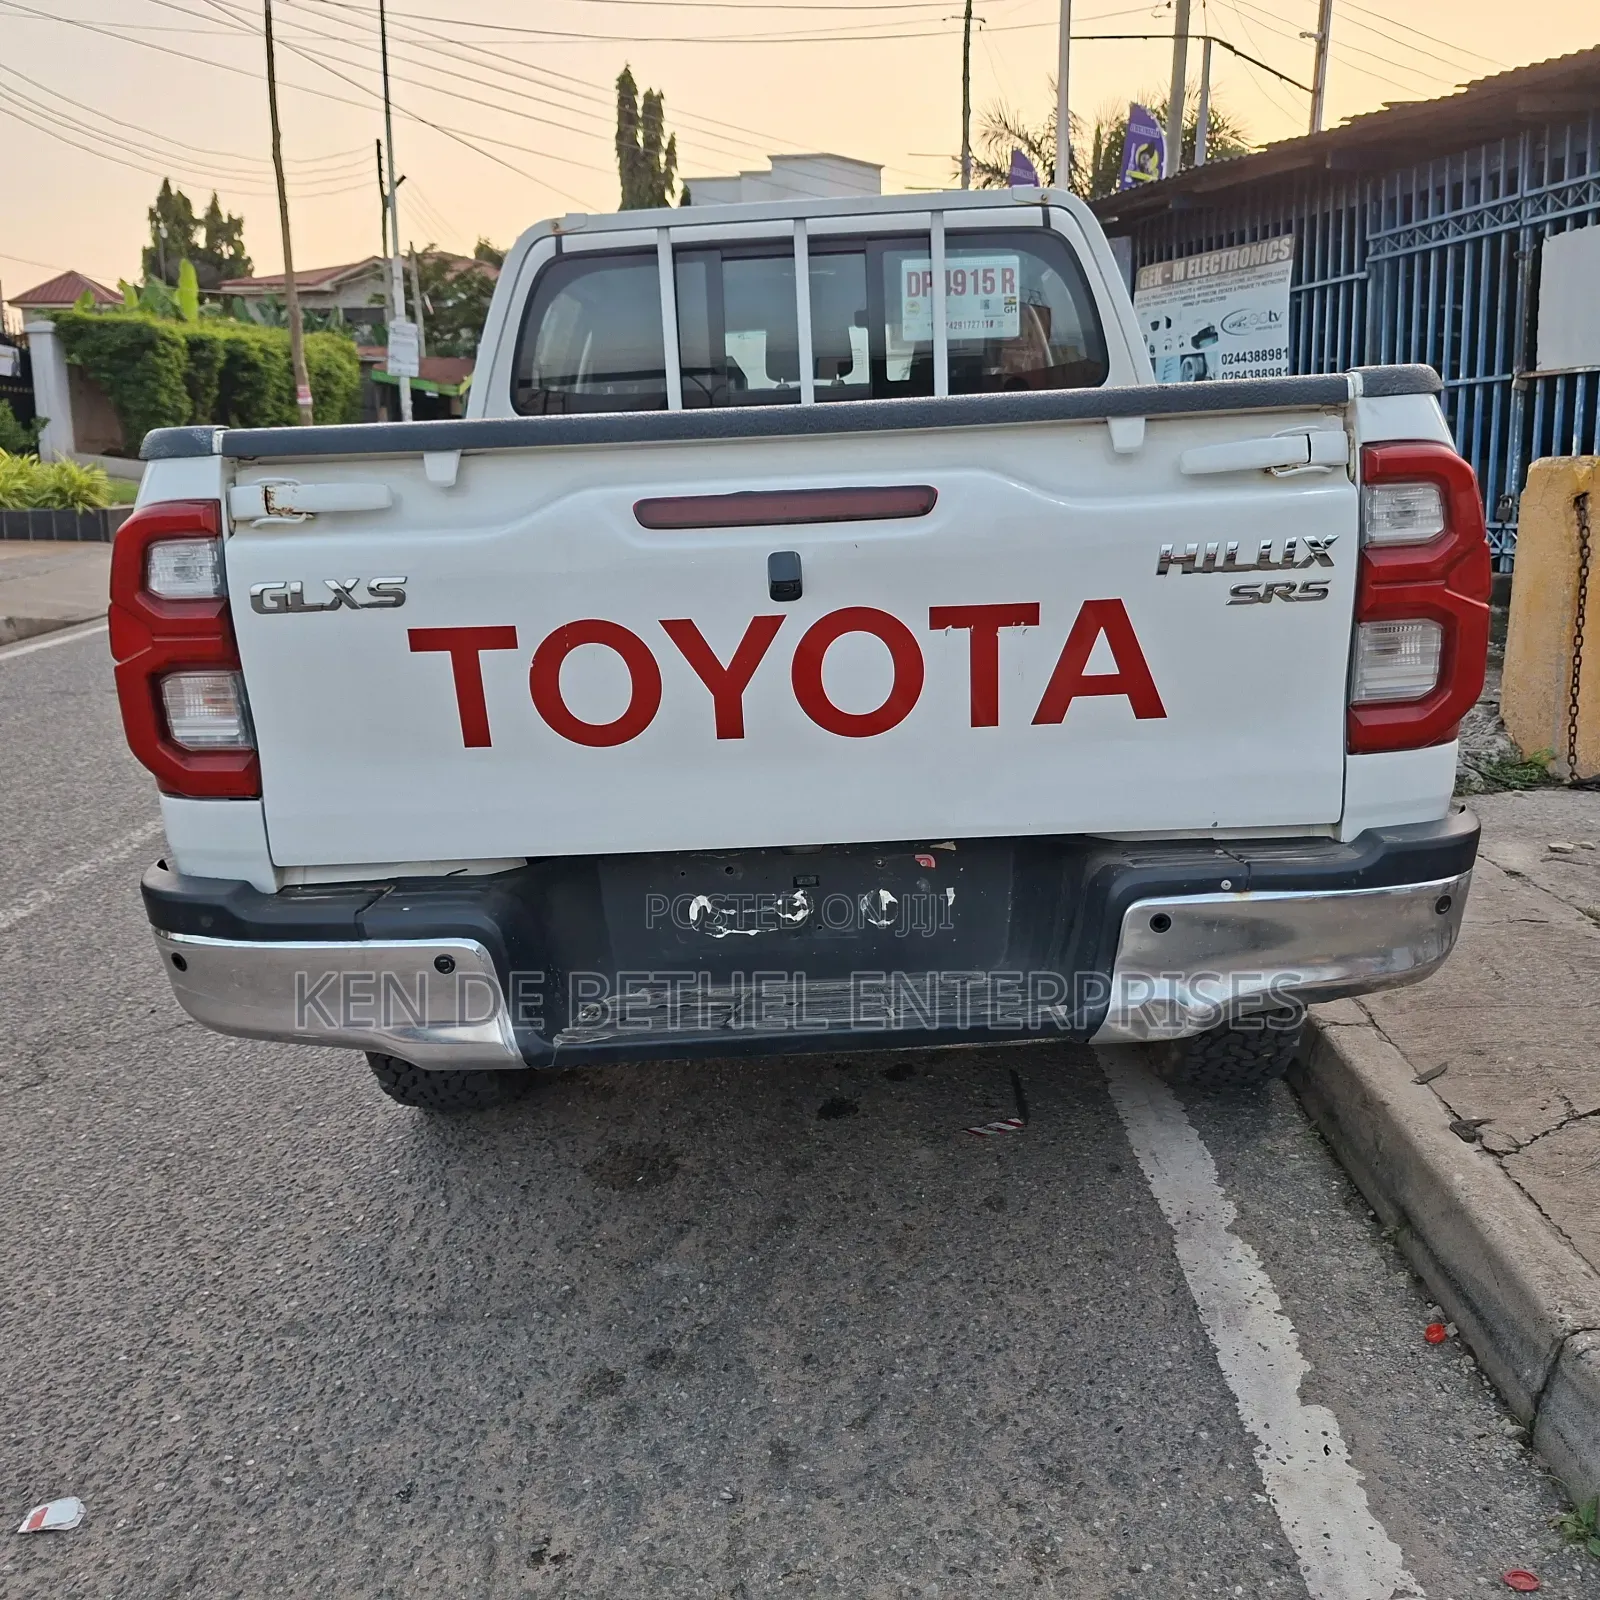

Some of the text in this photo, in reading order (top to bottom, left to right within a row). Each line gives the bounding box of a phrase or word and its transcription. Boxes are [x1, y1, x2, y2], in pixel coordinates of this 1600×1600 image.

[1172, 261, 1185, 282] M
[1187, 238, 1290, 279] ELECTRONICS
[1001, 267, 1016, 294] R
[1221, 347, 1288, 365] 0244388981
[1156, 534, 1339, 575] HILUX
[250, 576, 408, 615] GLXS
[1226, 579, 1331, 605] SR5
[407, 598, 1168, 748] TOYOTA
